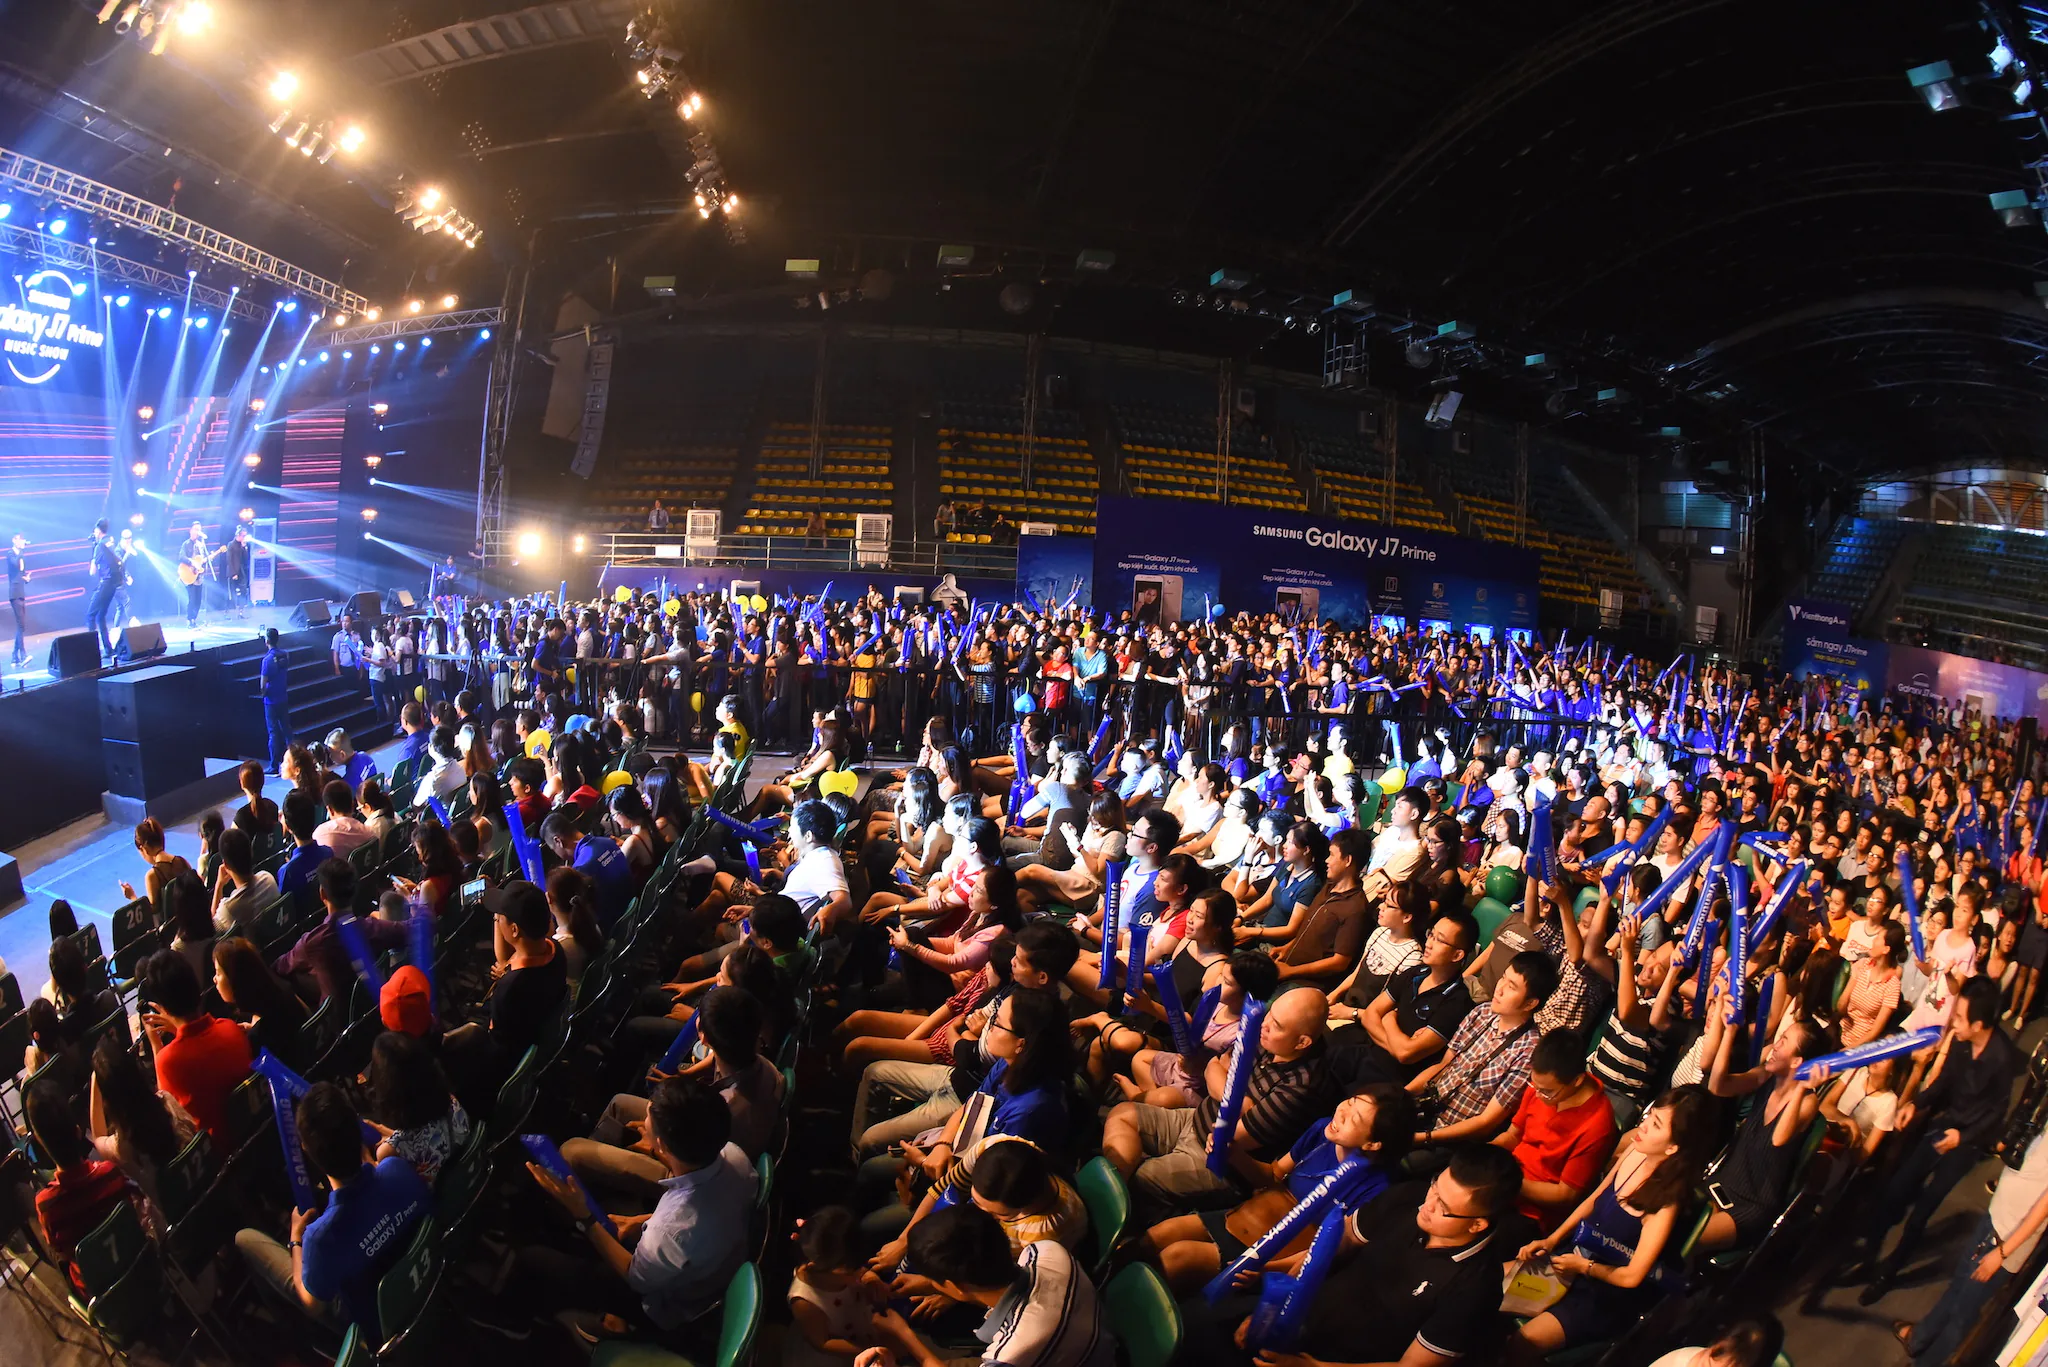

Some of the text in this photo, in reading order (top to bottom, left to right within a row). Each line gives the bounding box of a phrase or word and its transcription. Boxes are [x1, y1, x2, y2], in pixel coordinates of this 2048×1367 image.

[0, 304, 49, 342] alaxy
[45, 313, 70, 339] J7
[4, 339, 70, 360] MUSIC SHOW
[1253, 525, 1437, 561] SAMSUNG Galaxy J7 Prime
[1144, 554, 1169, 563] Galaxy
[1286, 568, 1307, 576] Galaxy
[1823, 641, 1843, 654] ngay
[1753, 840, 1778, 857] SAMSUNG
[126, 904, 143, 930] 26
[1108, 882, 1119, 943] SAMSUNG
[1845, 1031, 1917, 1056] SAMSUNG
[279, 1097, 309, 1187] SAMSUNG
[359, 1213, 391, 1250] SAMSUNG
[366, 1222, 396, 1257] Galaxy
[394, 1211, 404, 1227] J7
